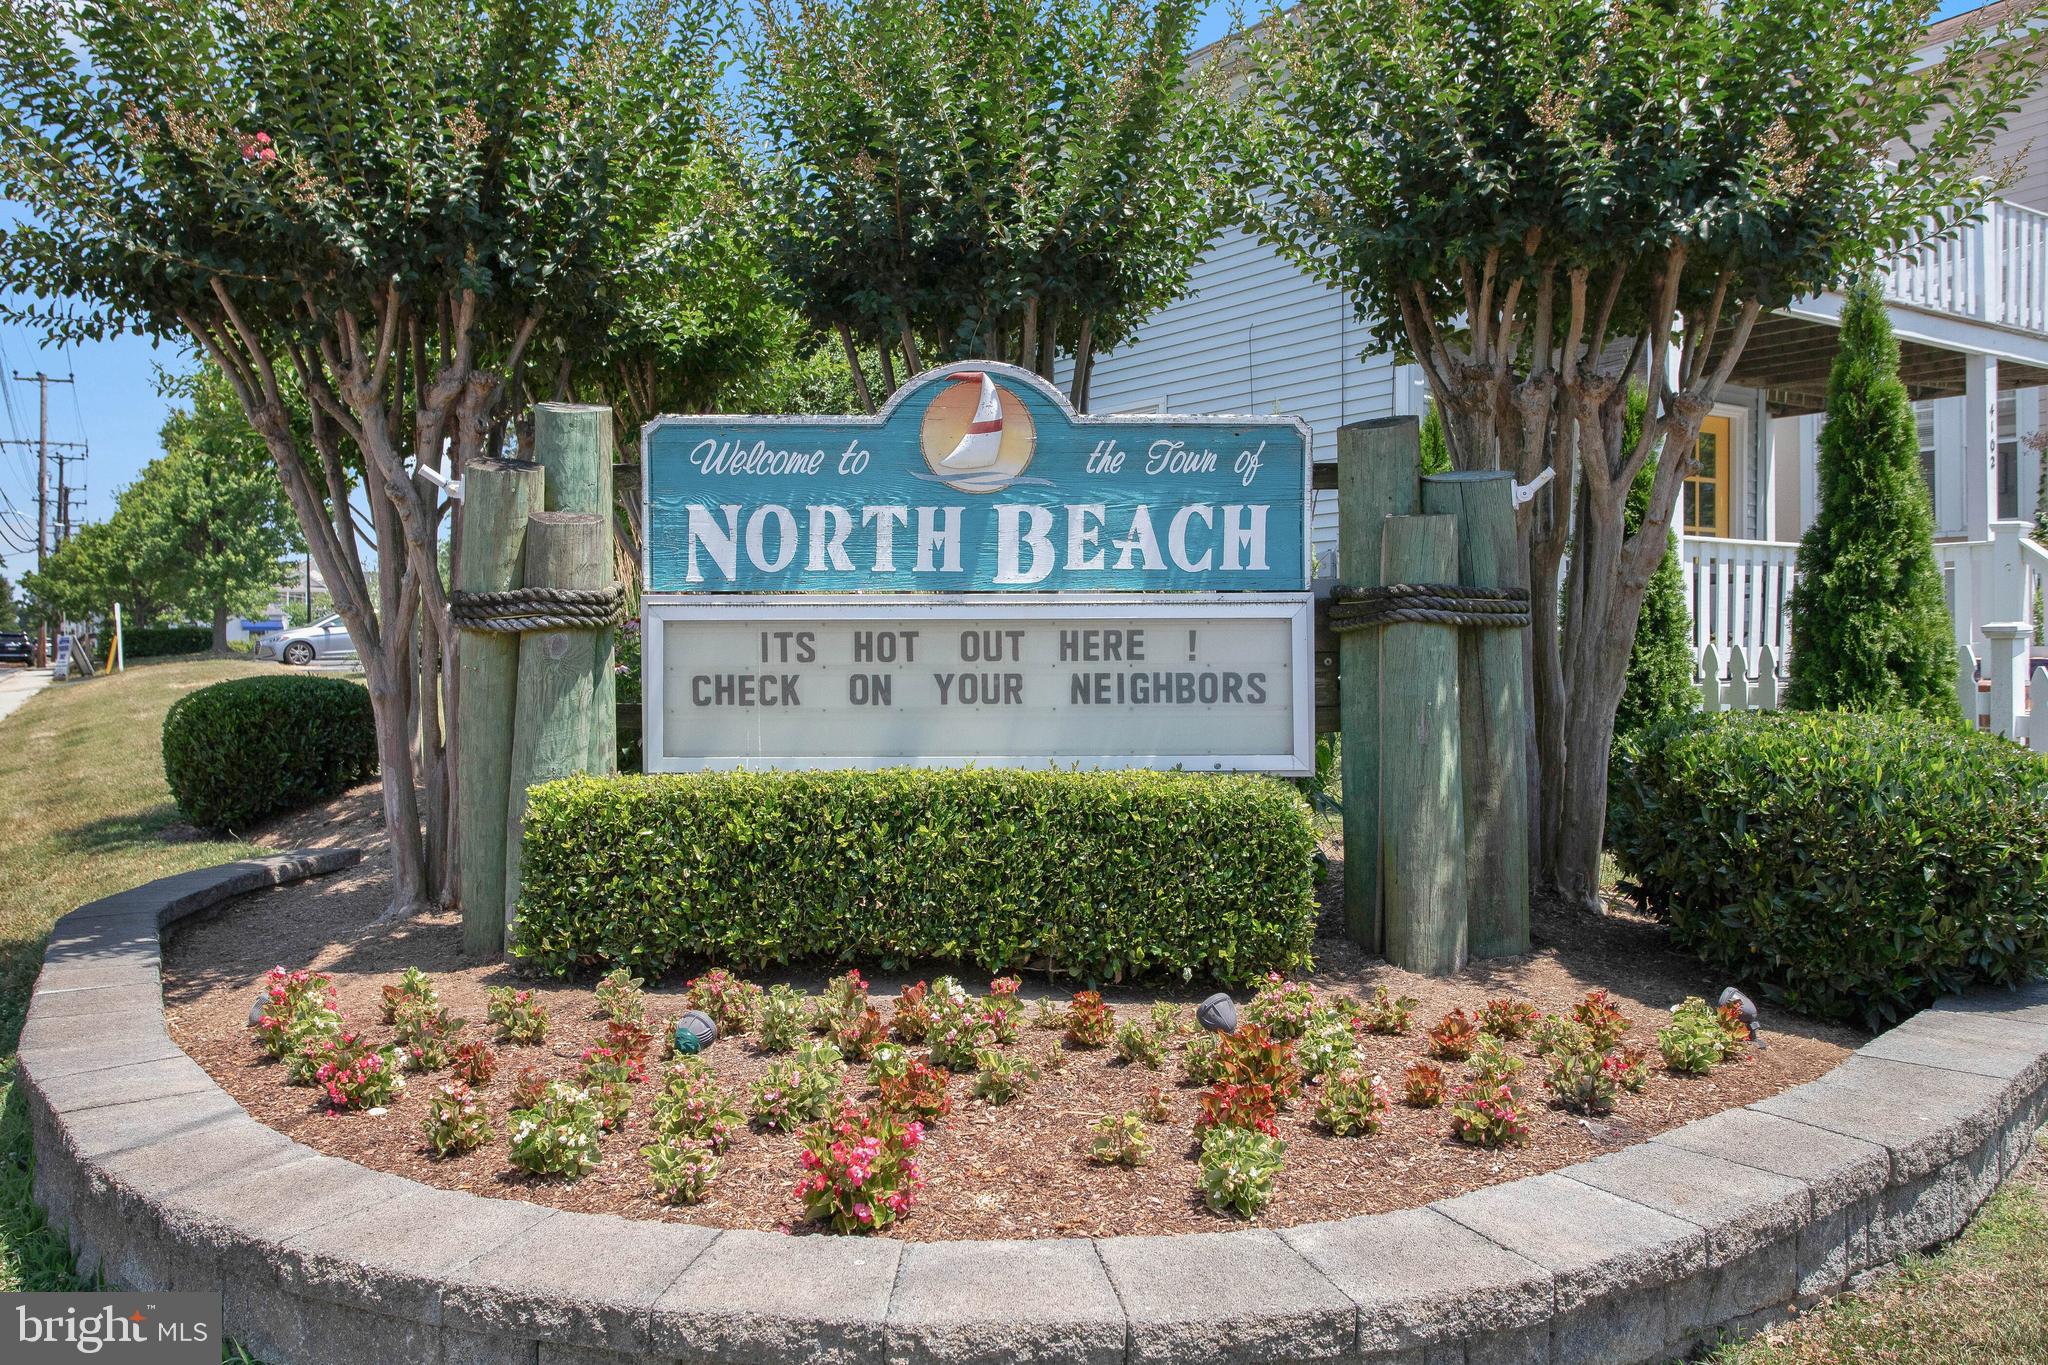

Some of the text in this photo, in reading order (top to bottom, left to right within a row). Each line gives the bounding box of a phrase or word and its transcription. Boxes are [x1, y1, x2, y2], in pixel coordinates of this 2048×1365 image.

[690, 439, 1266, 486] Welcome to the Town of
[685, 503, 1270, 584] NORTH BEACH
[761, 631, 816, 663] ITS
[854, 631, 919, 662] HOT
[960, 630, 1025, 662] OUT
[1059, 629, 1145, 662] HERE
[692, 672, 1267, 707] CHECK ON YOUR NEIGHBORS
